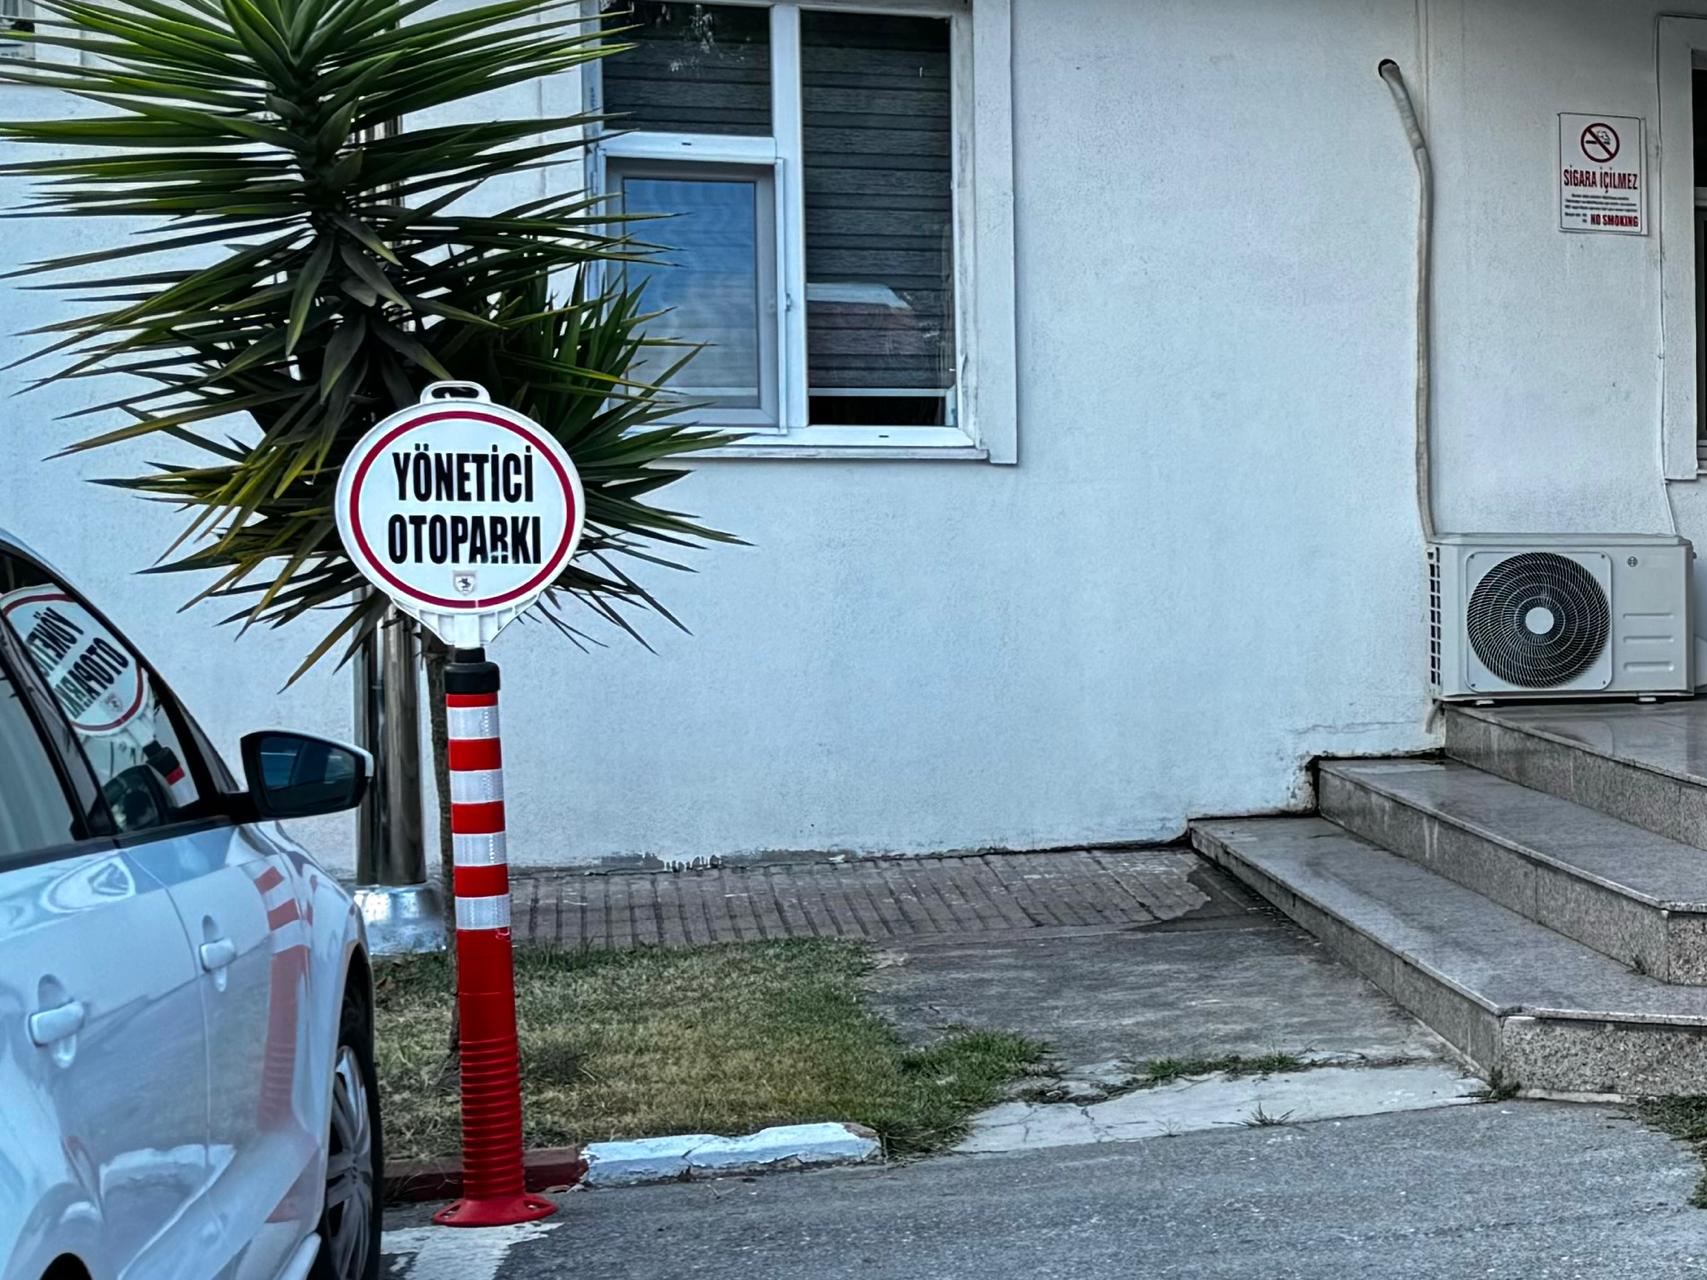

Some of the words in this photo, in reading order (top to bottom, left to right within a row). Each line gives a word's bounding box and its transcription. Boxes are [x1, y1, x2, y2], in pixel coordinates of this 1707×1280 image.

[1563, 164, 1597, 188] SİGARA
[1600, 166, 1638, 194] İÇİLMEZ
[1590, 213, 1601, 226] NO
[392, 443, 533, 503] YÖNETİCİ
[387, 513, 542, 565] OTOPARKI
